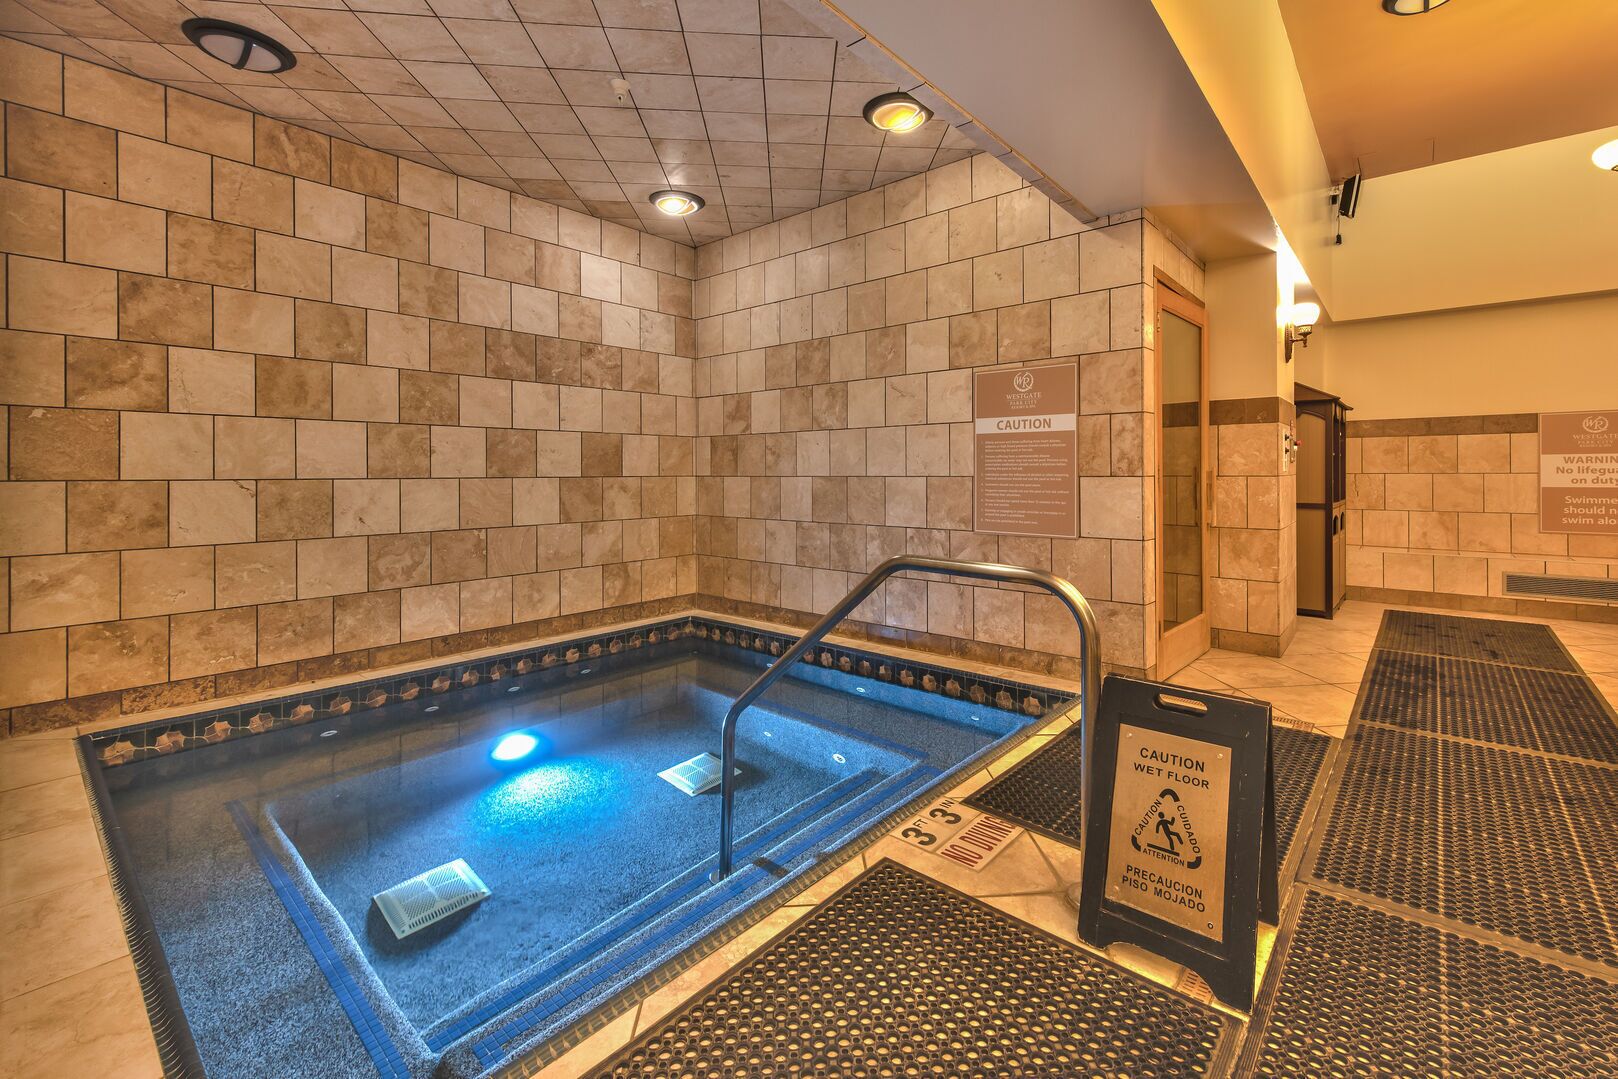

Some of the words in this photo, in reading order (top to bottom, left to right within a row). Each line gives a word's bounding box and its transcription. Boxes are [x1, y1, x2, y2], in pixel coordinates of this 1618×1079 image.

[1006, 392, 1042, 400] WESTGATE
[997, 418, 1052, 431] CAUTION
[1556, 466, 1573, 474] No
[1571, 477, 1587, 485] on
[1562, 516, 1594, 524] swim
[1563, 505, 1606, 514] should
[1140, 747, 1205, 773] CAUTION
[1134, 762, 1164, 777] WET
[1167, 771, 1210, 790] FLOOR
[901, 827, 937, 846] 3
[929, 808, 962, 825] 3
[1134, 799, 1163, 836] CAUTION
[1176, 805, 1201, 854] CUIDADO
[940, 844, 984, 868] NO
[1143, 848, 1185, 867] ATTENTION
[1122, 875, 1148, 892] PISO
[1153, 887, 1206, 913] MOJADO
[1126, 864, 1203, 900] PRECAUCION
